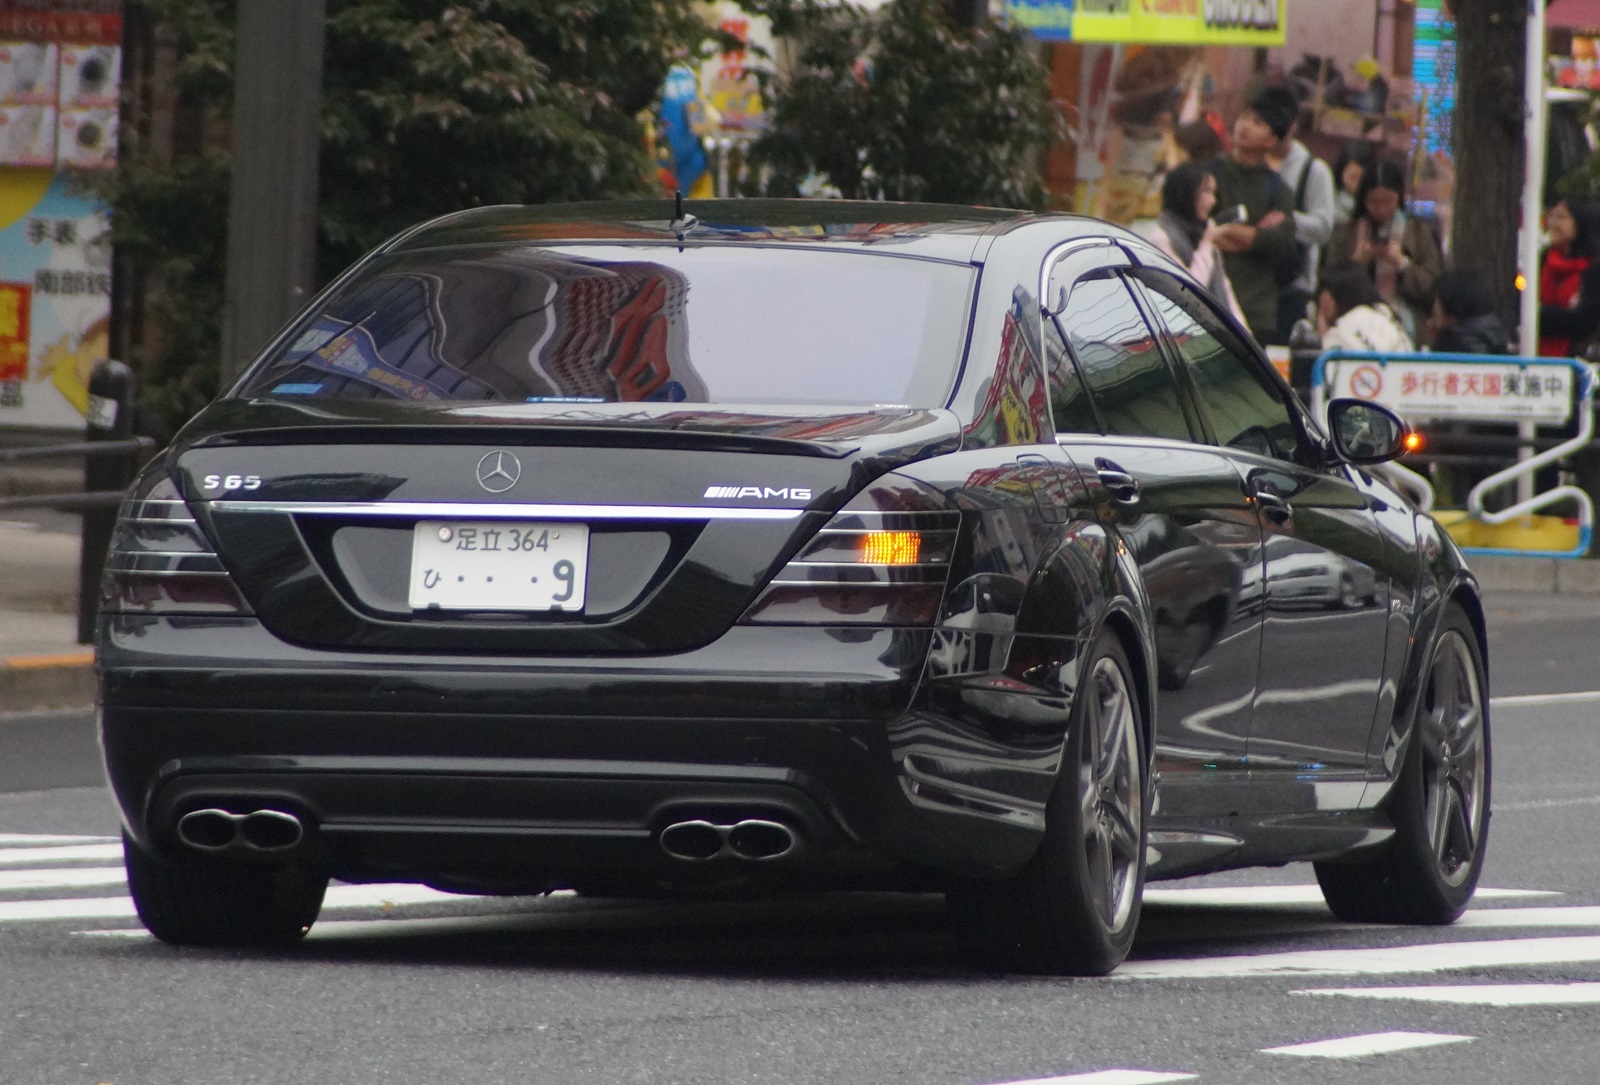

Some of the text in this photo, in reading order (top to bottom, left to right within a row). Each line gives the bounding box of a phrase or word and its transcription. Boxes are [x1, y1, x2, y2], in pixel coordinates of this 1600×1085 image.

[1401, 370, 1563, 397] 歩行者天国実施中
[737, 486, 812, 500] AMG
[456, 528, 549, 552] 足立 364
